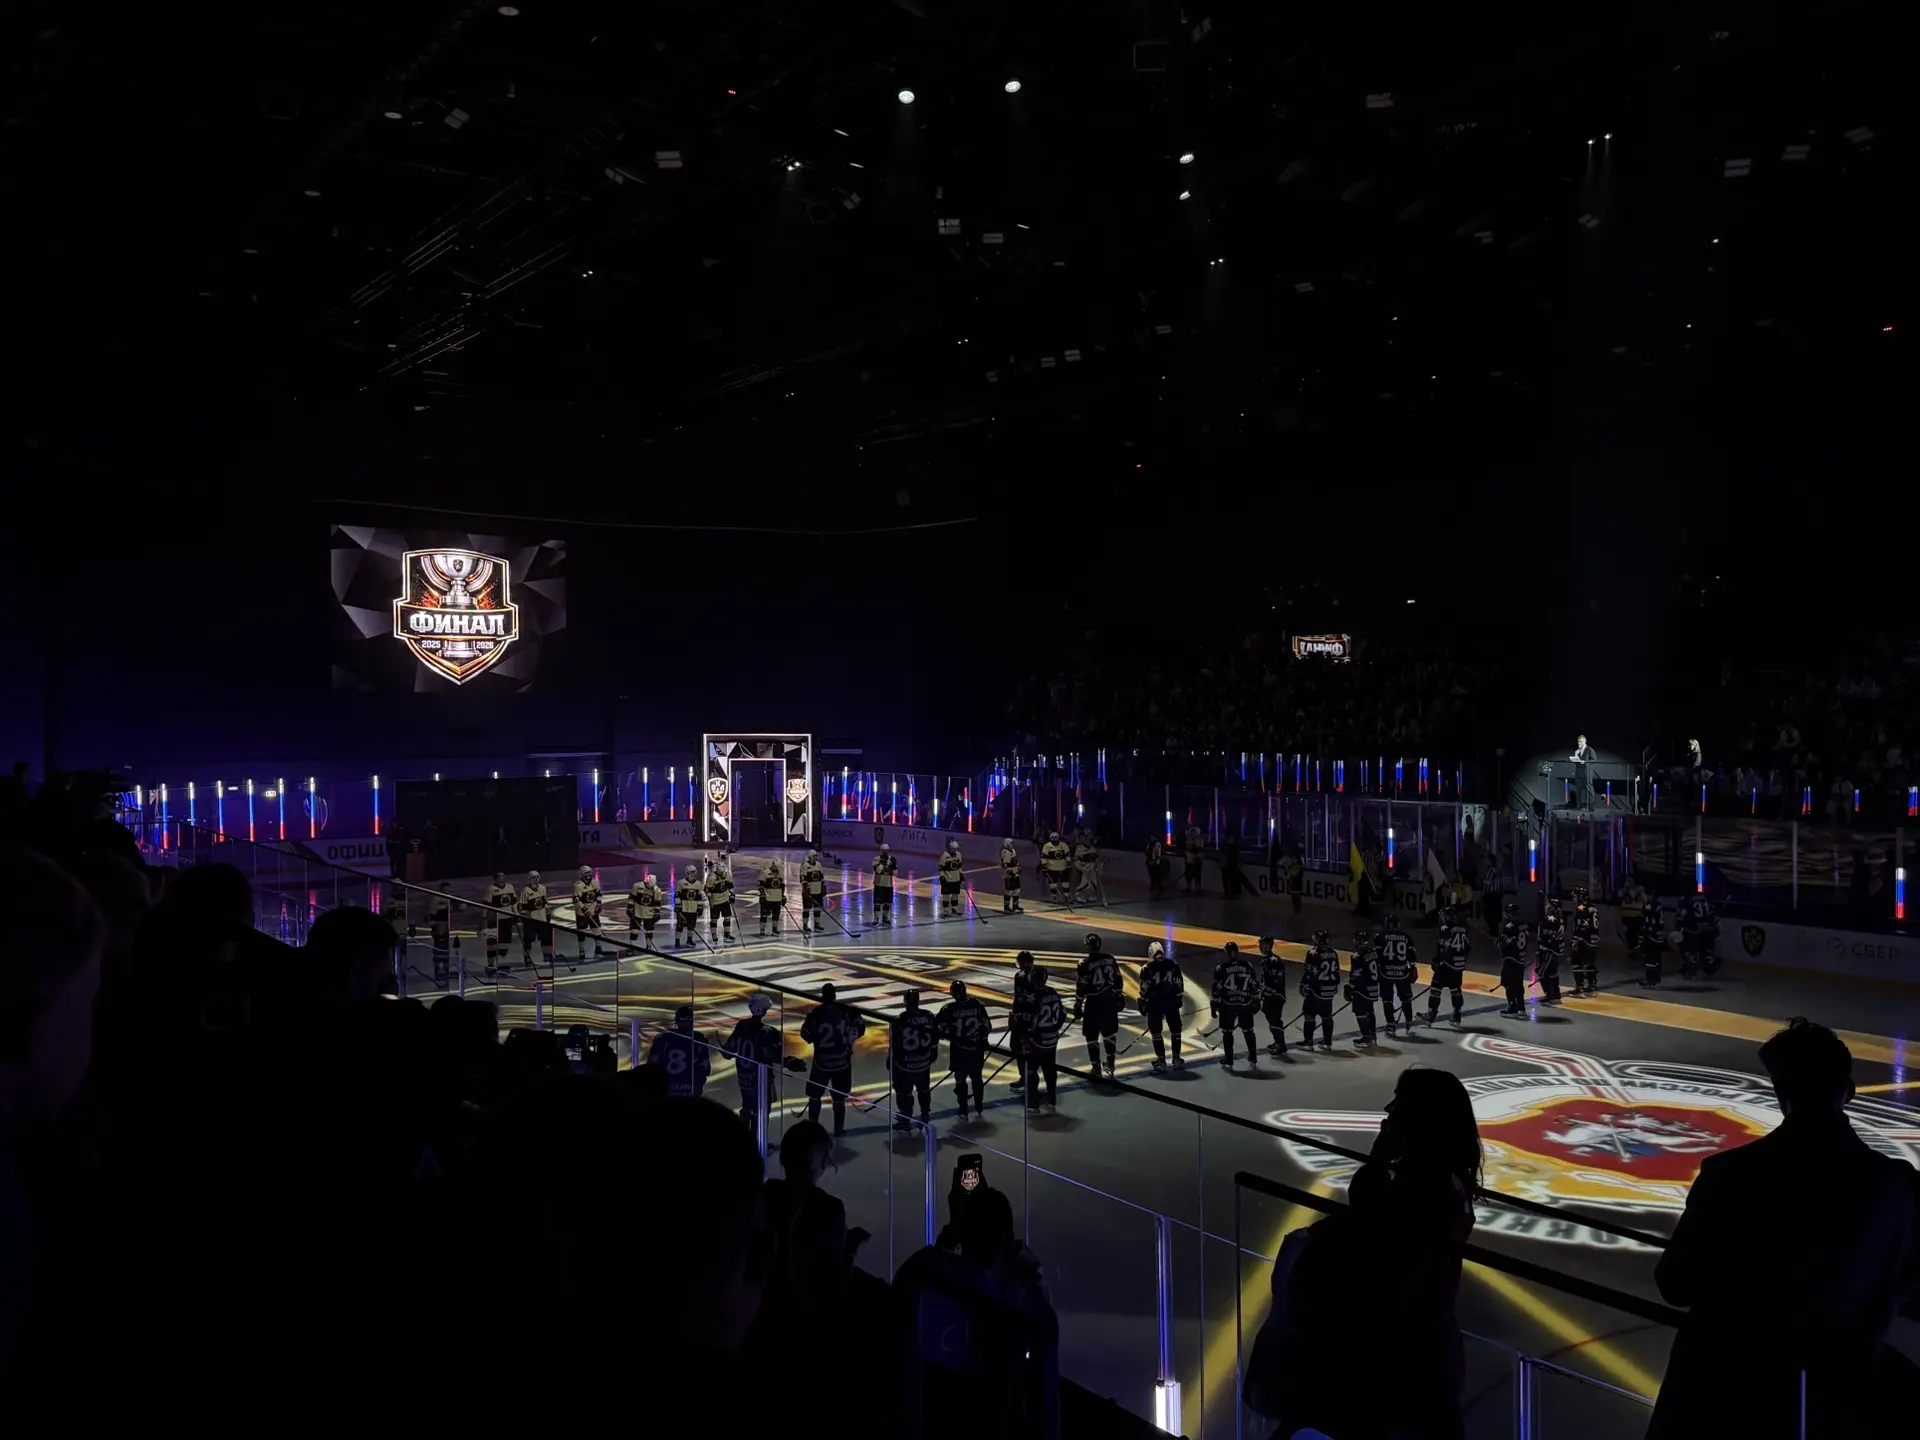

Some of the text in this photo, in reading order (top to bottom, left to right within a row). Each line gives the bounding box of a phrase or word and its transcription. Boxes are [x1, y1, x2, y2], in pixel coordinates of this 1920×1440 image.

[409, 611, 505, 635] ФИНАЛ
[421, 639, 441, 649] 2025
[578, 830, 600, 843] ГА
[672, 827, 695, 836] NAV
[1383, 940, 1407, 961] 49
[1852, 942, 1900, 960] СБЕР
[1223, 972, 1251, 991] 47
[952, 1016, 979, 1038] 12
[1571, 1078, 1612, 1088] ПО
[1617, 1079, 1745, 1100] РОССИИ
